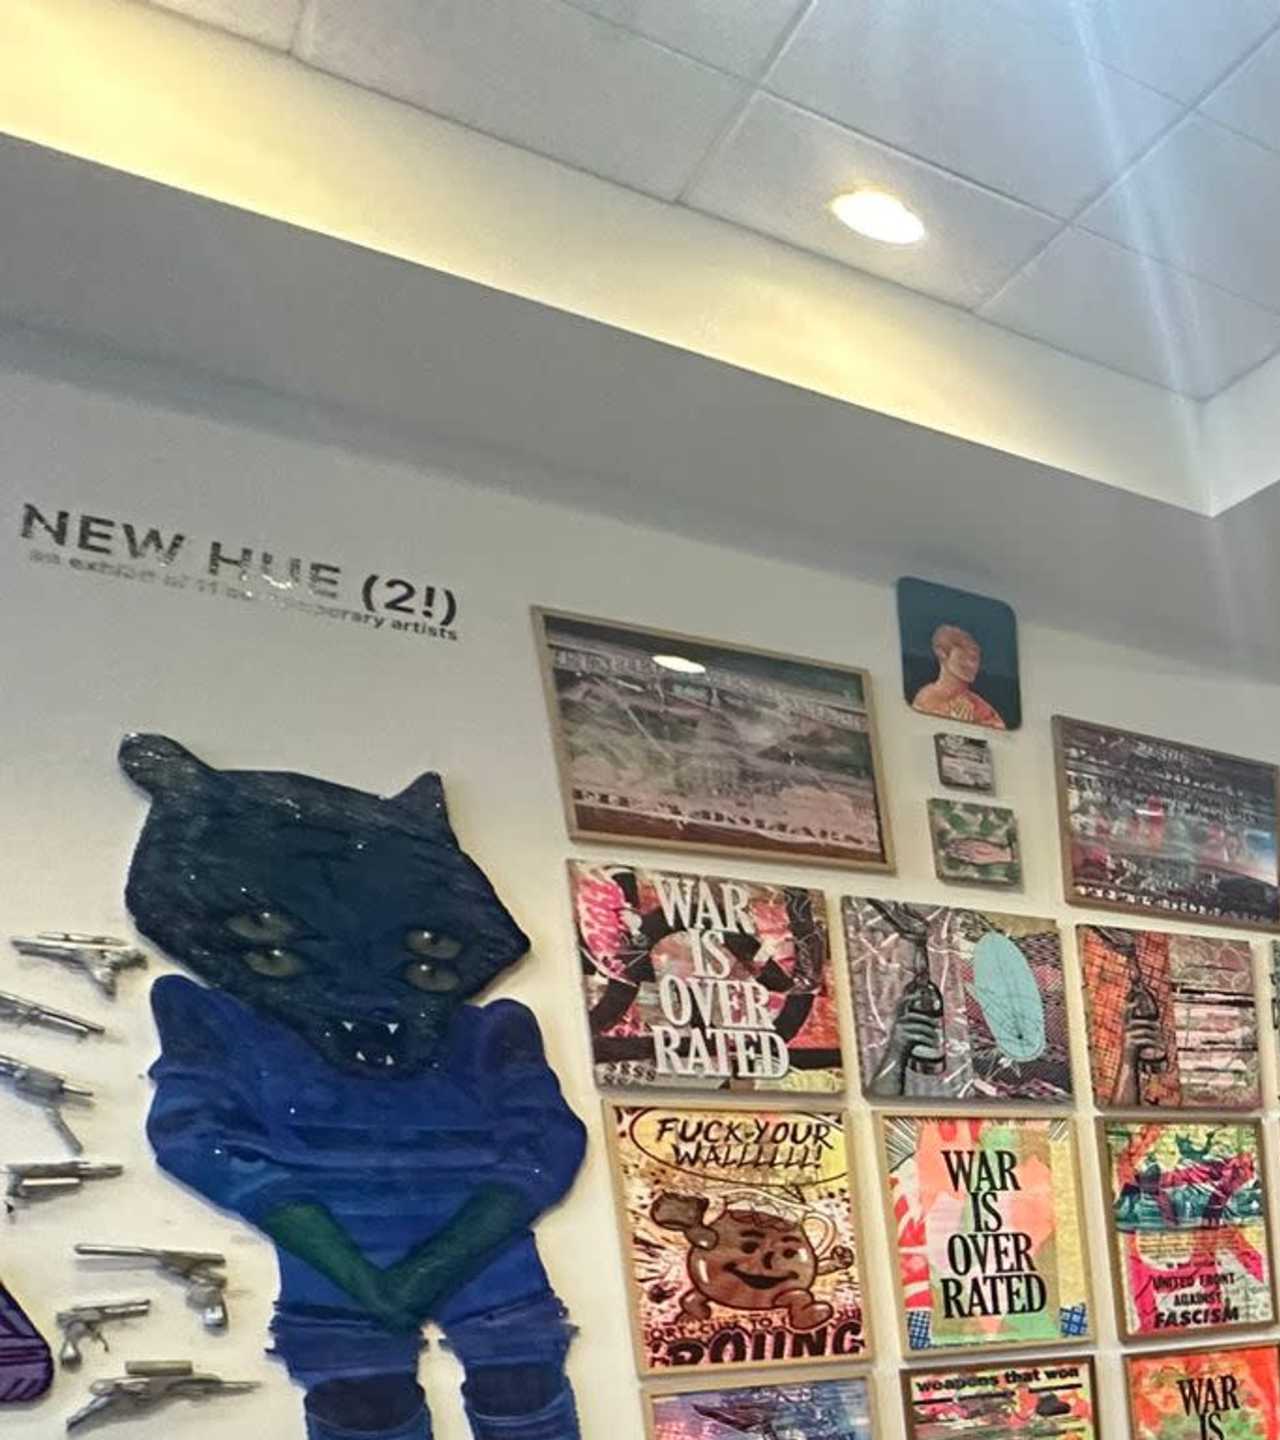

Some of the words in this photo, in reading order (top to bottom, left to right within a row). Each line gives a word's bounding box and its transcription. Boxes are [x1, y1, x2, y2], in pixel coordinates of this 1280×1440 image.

[21, 503, 185, 564] NEW
[208, 541, 341, 598] HUE
[361, 574, 457, 627] (2!)
[391, 617, 458, 641] artists
[654, 875, 755, 933] WAR
[689, 929, 731, 980] IS
[659, 974, 776, 1030] OVER
[650, 1024, 790, 1079] RATED
[657, 1118, 741, 1143] FUCK
[755, 1119, 833, 1150] YOUR
[941, 1150, 1021, 1192] WAR
[970, 1191, 1002, 1232] IS
[947, 1231, 1036, 1276] OVER
[940, 1273, 1047, 1319] RATED
[1152, 1274, 1195, 1289] UNITED
[1199, 1272, 1235, 1286] FRONT
[1174, 1291, 1222, 1306] AGAINST
[1154, 1306, 1239, 1328] FASCISM
[916, 1375, 999, 1393] weapons
[1004, 1366, 1040, 1384] that
[1046, 1366, 1079, 1379] won
[1176, 1374, 1240, 1417] WAR
